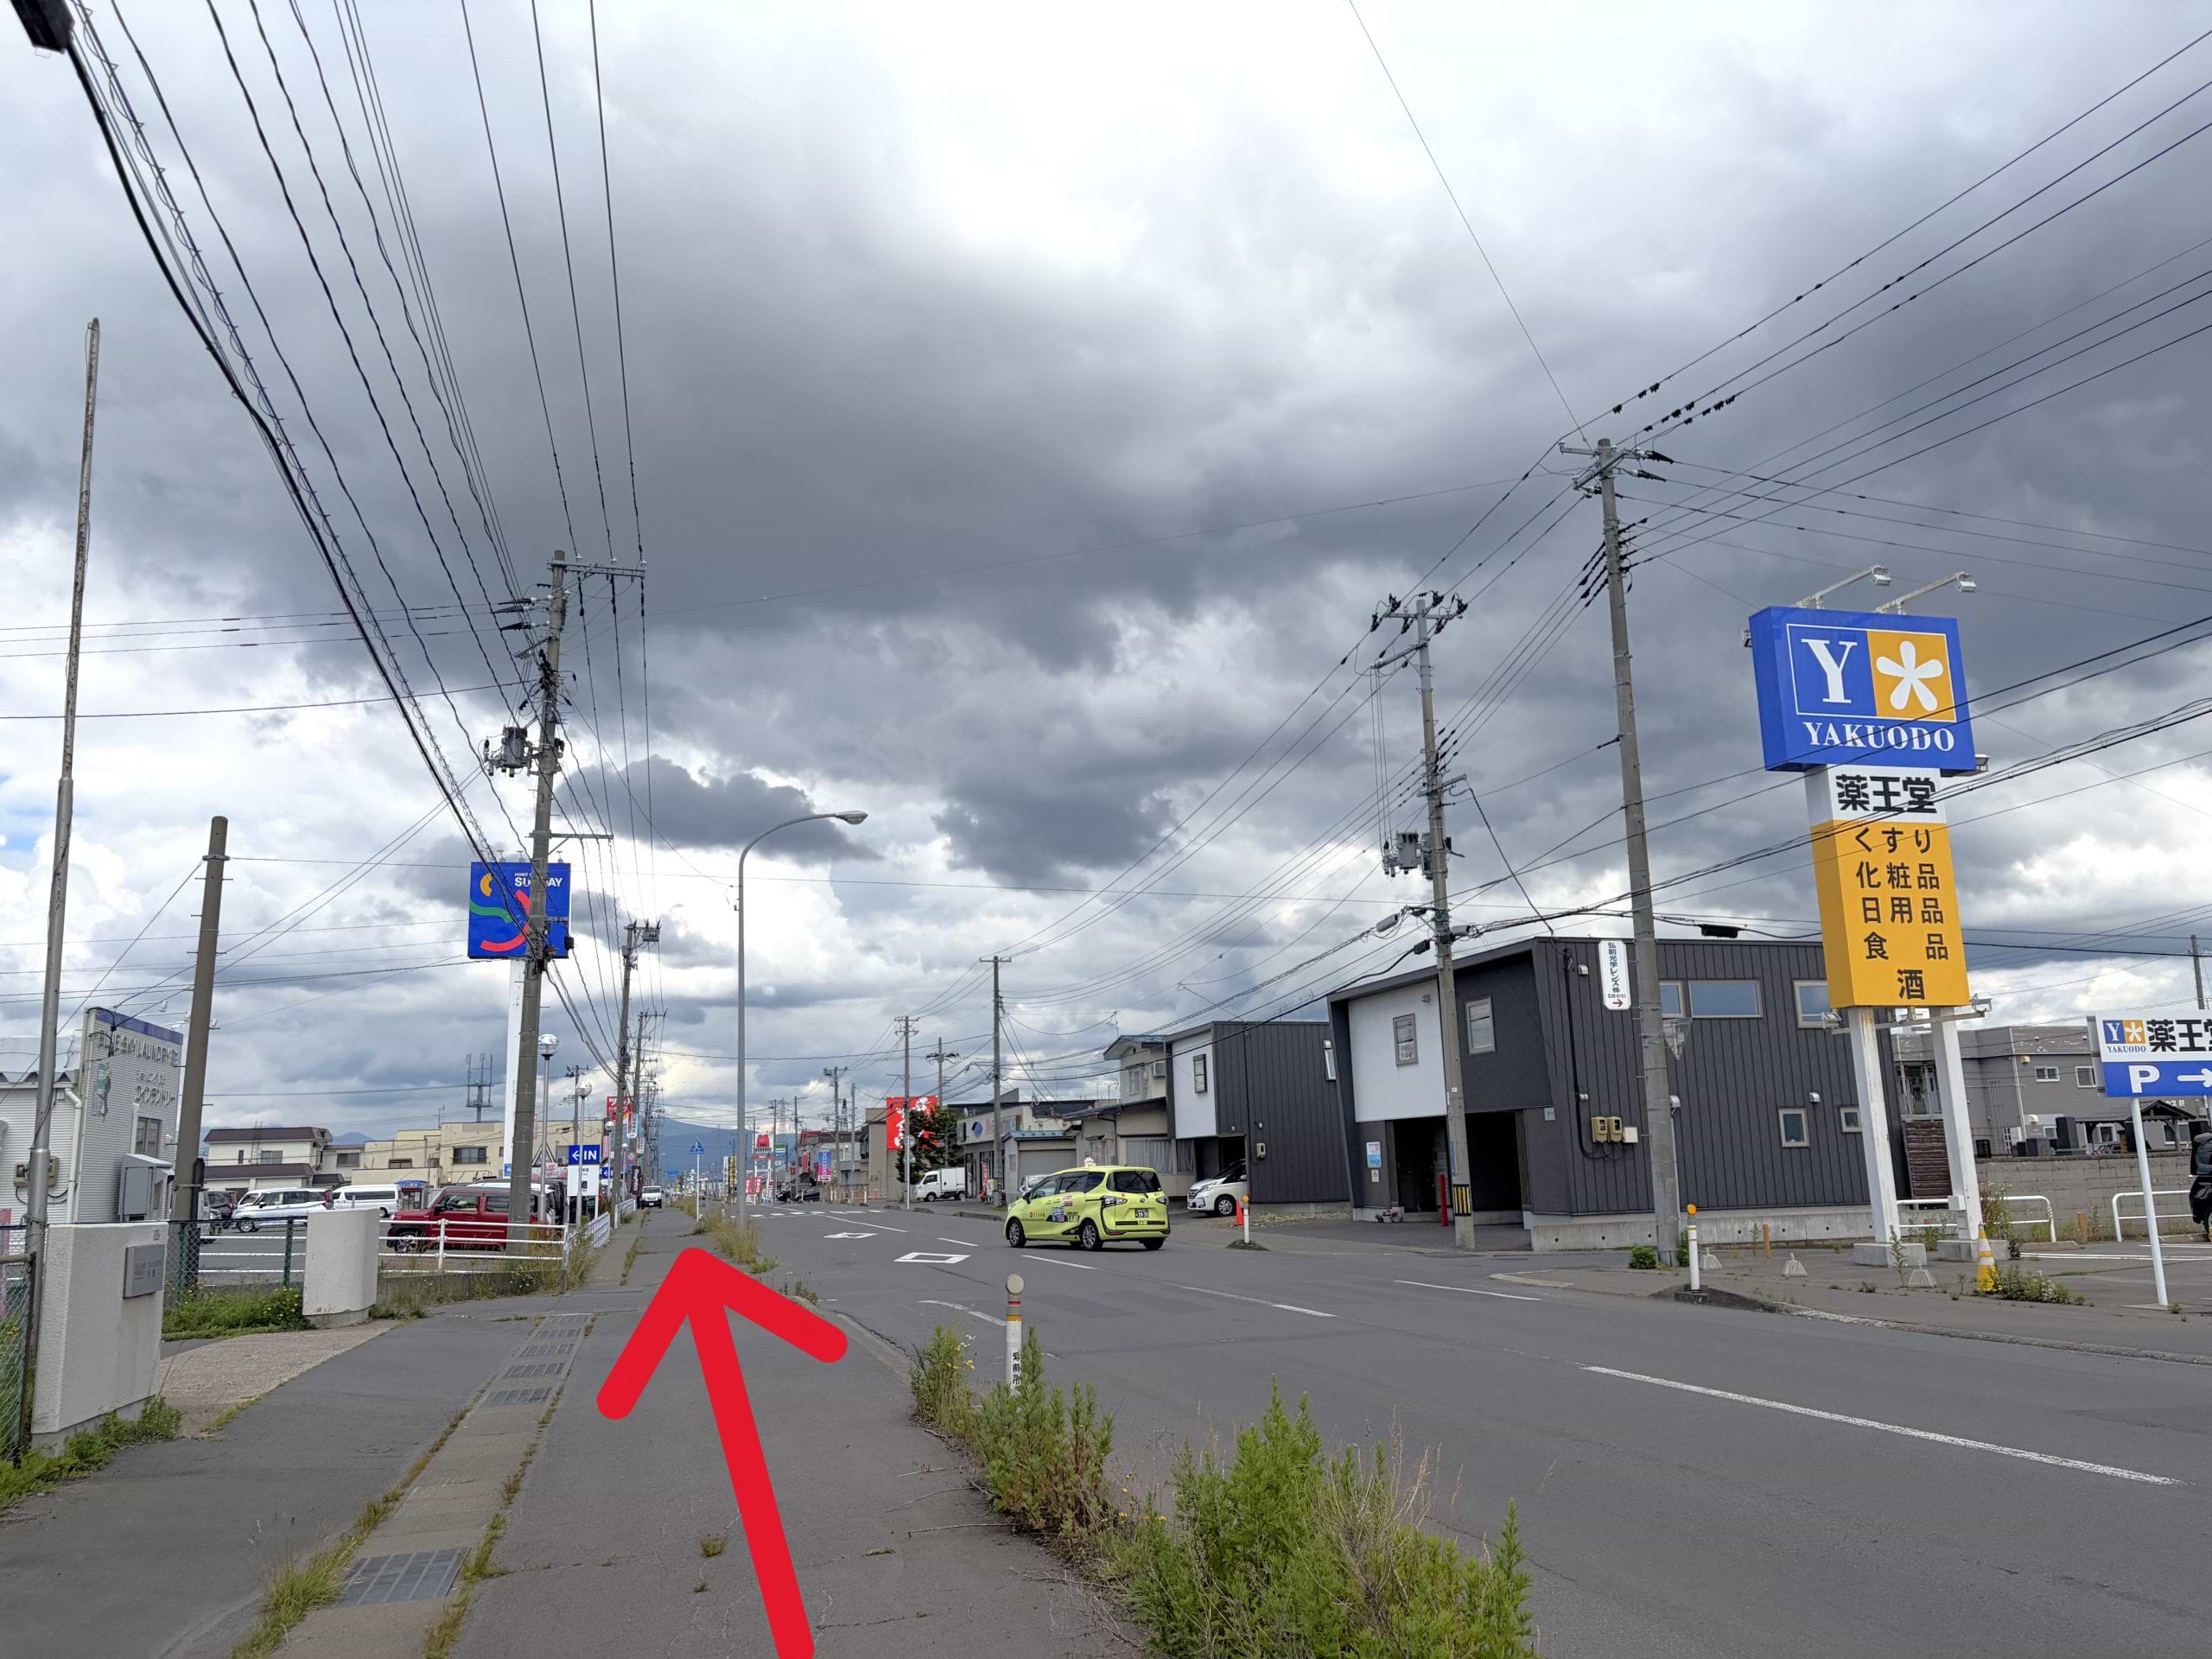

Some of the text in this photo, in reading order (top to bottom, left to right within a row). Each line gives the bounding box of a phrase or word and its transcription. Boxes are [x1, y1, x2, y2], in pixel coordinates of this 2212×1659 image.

[1801, 639, 1858, 704] Y
[1802, 721, 1955, 752] YAKUODO
[1835, 774, 1937, 814] 薬王堂
[1855, 827, 1930, 854] くすり
[514, 877, 563, 887] SUAY
[1855, 861, 1940, 890] 化粧品
[1861, 897, 1944, 924] 日用品
[1897, 969, 1925, 1000] 酒
[2105, 1022, 2120, 1041] Y
[2128, 1065, 2160, 1094] P
[583, 1150, 597, 1160] IN
